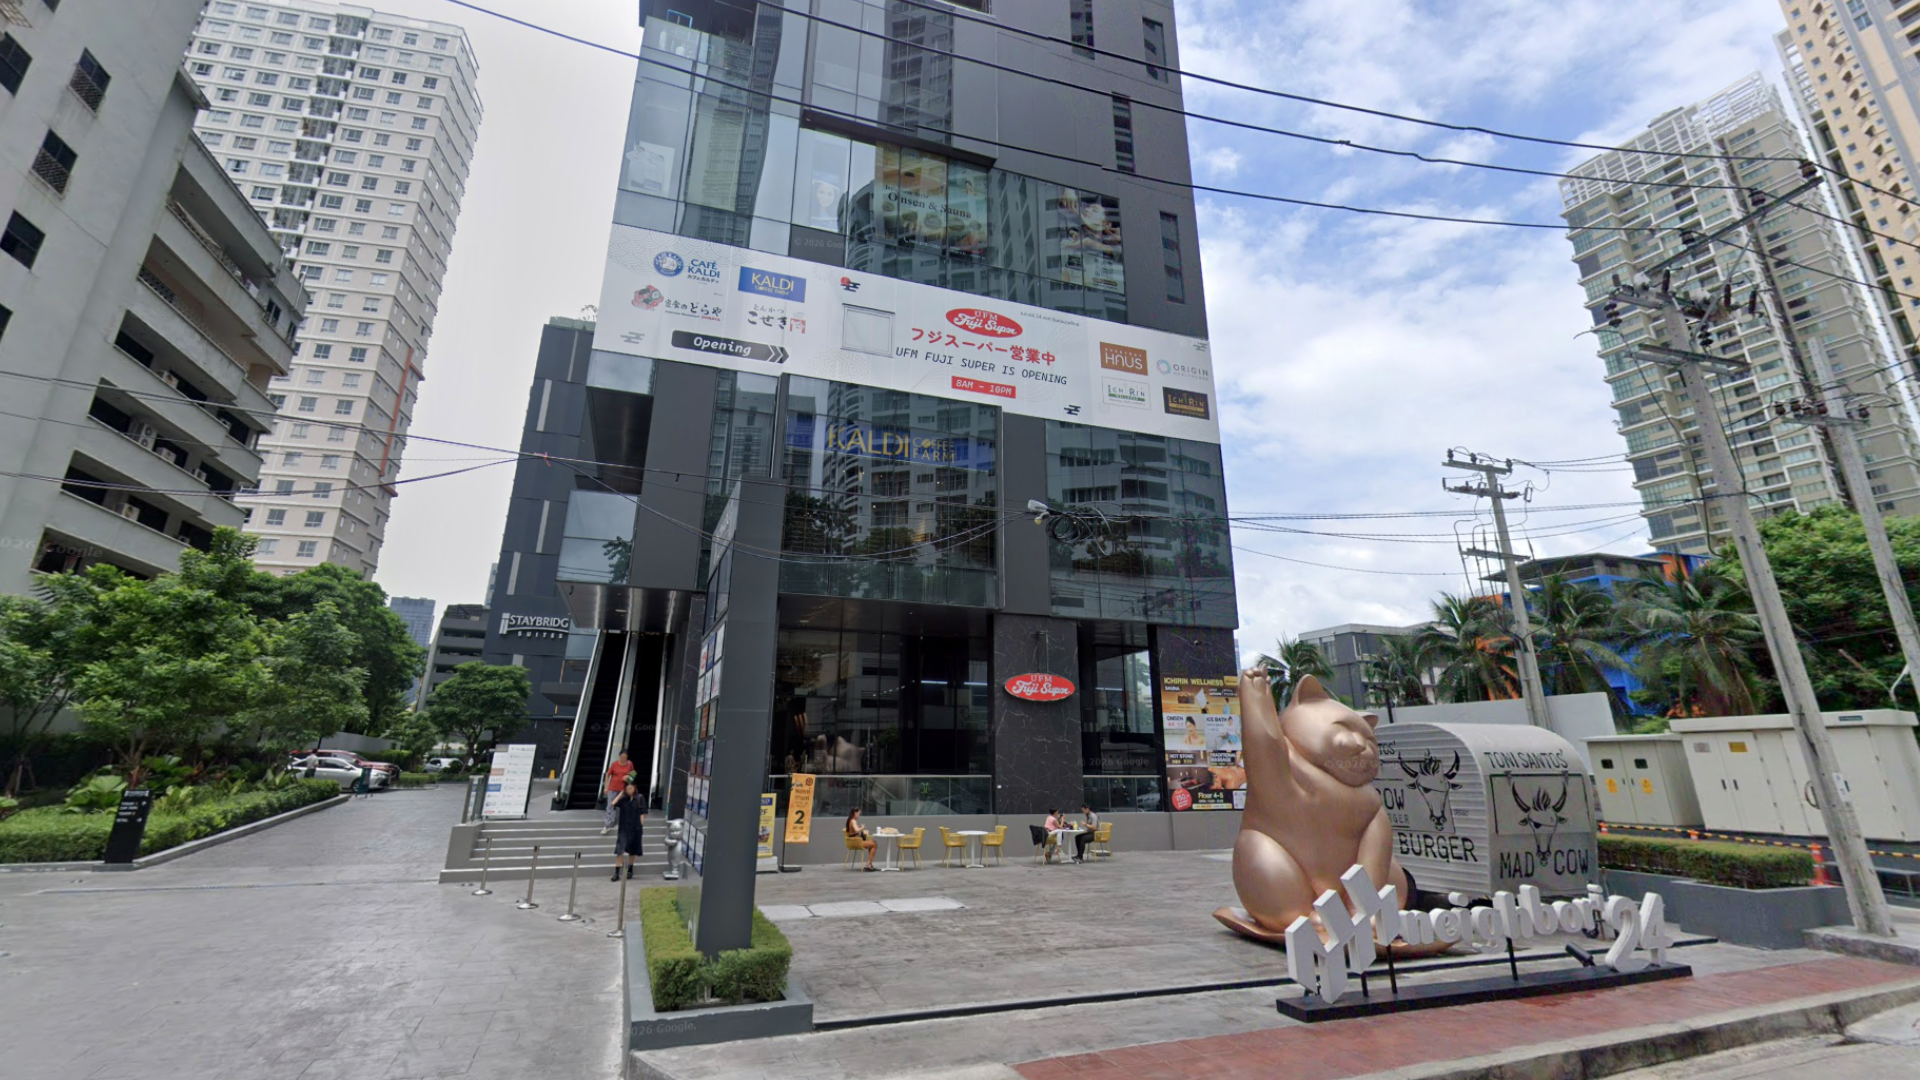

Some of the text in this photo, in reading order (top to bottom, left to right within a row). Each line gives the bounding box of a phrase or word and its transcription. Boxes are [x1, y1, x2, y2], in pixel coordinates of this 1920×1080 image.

[888, 191, 926, 209] Onsen
[940, 204, 972, 219] Sauna
[687, 265, 720, 279] KALDI
[690, 258, 718, 271] CAFÉ
[751, 272, 794, 292] KALDI
[953, 312, 1018, 335] Fuji Super
[973, 310, 999, 322] UFM
[693, 336, 752, 357] Opening
[911, 327, 1056, 367] フジスーパー営業中
[895, 346, 1068, 386] UFM FUJI SUPER IS OPENING
[1172, 363, 1209, 377] ORIGIN
[955, 379, 974, 389] 8AM
[989, 383, 1013, 396] 10PM
[828, 423, 910, 459] KALDI
[912, 436, 956, 450] COFFEE
[912, 450, 956, 464] FARM
[509, 614, 570, 629] STAYBRIDG
[517, 630, 564, 639] SUITES
[1030, 674, 1063, 683] UFM
[1163, 677, 1189, 685] ICHIRIN
[1190, 678, 1224, 687] WELLNESS
[1011, 679, 1070, 697] Fuji Super
[1483, 748, 1569, 769] TONI SANTOS'
[1376, 787, 1405, 811] OW
[793, 809, 806, 825] 2
[1397, 831, 1478, 863] BURGER
[1499, 848, 1590, 879] MAD COW
[1604, 891, 1675, 973] 24
